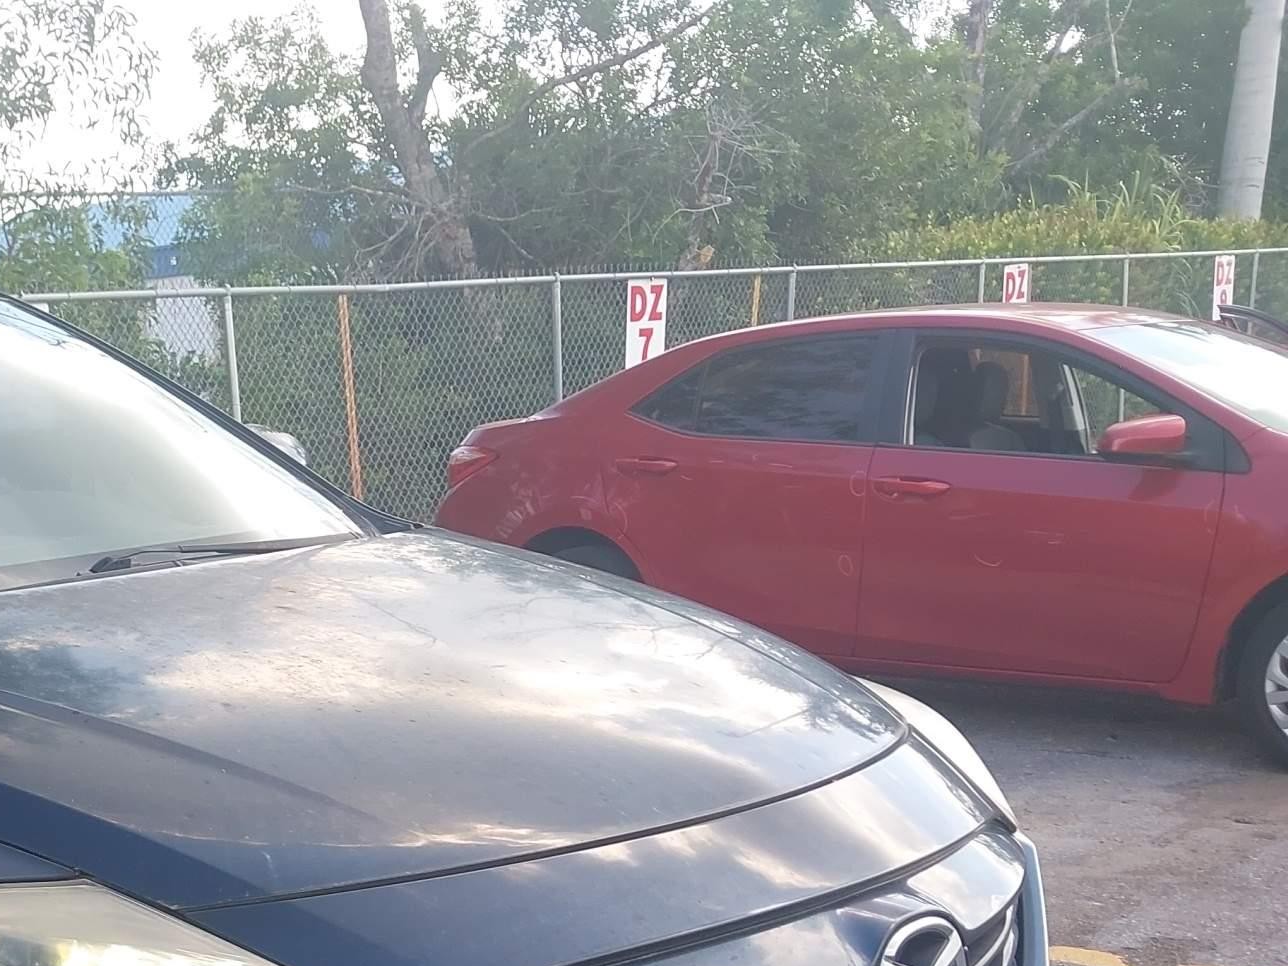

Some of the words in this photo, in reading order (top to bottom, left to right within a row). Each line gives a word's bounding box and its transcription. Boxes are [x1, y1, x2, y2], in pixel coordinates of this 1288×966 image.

[1005, 269, 1026, 304] DZ
[1216, 259, 1232, 286] DZ
[629, 284, 665, 323] DZ
[638, 327, 654, 361] 7
